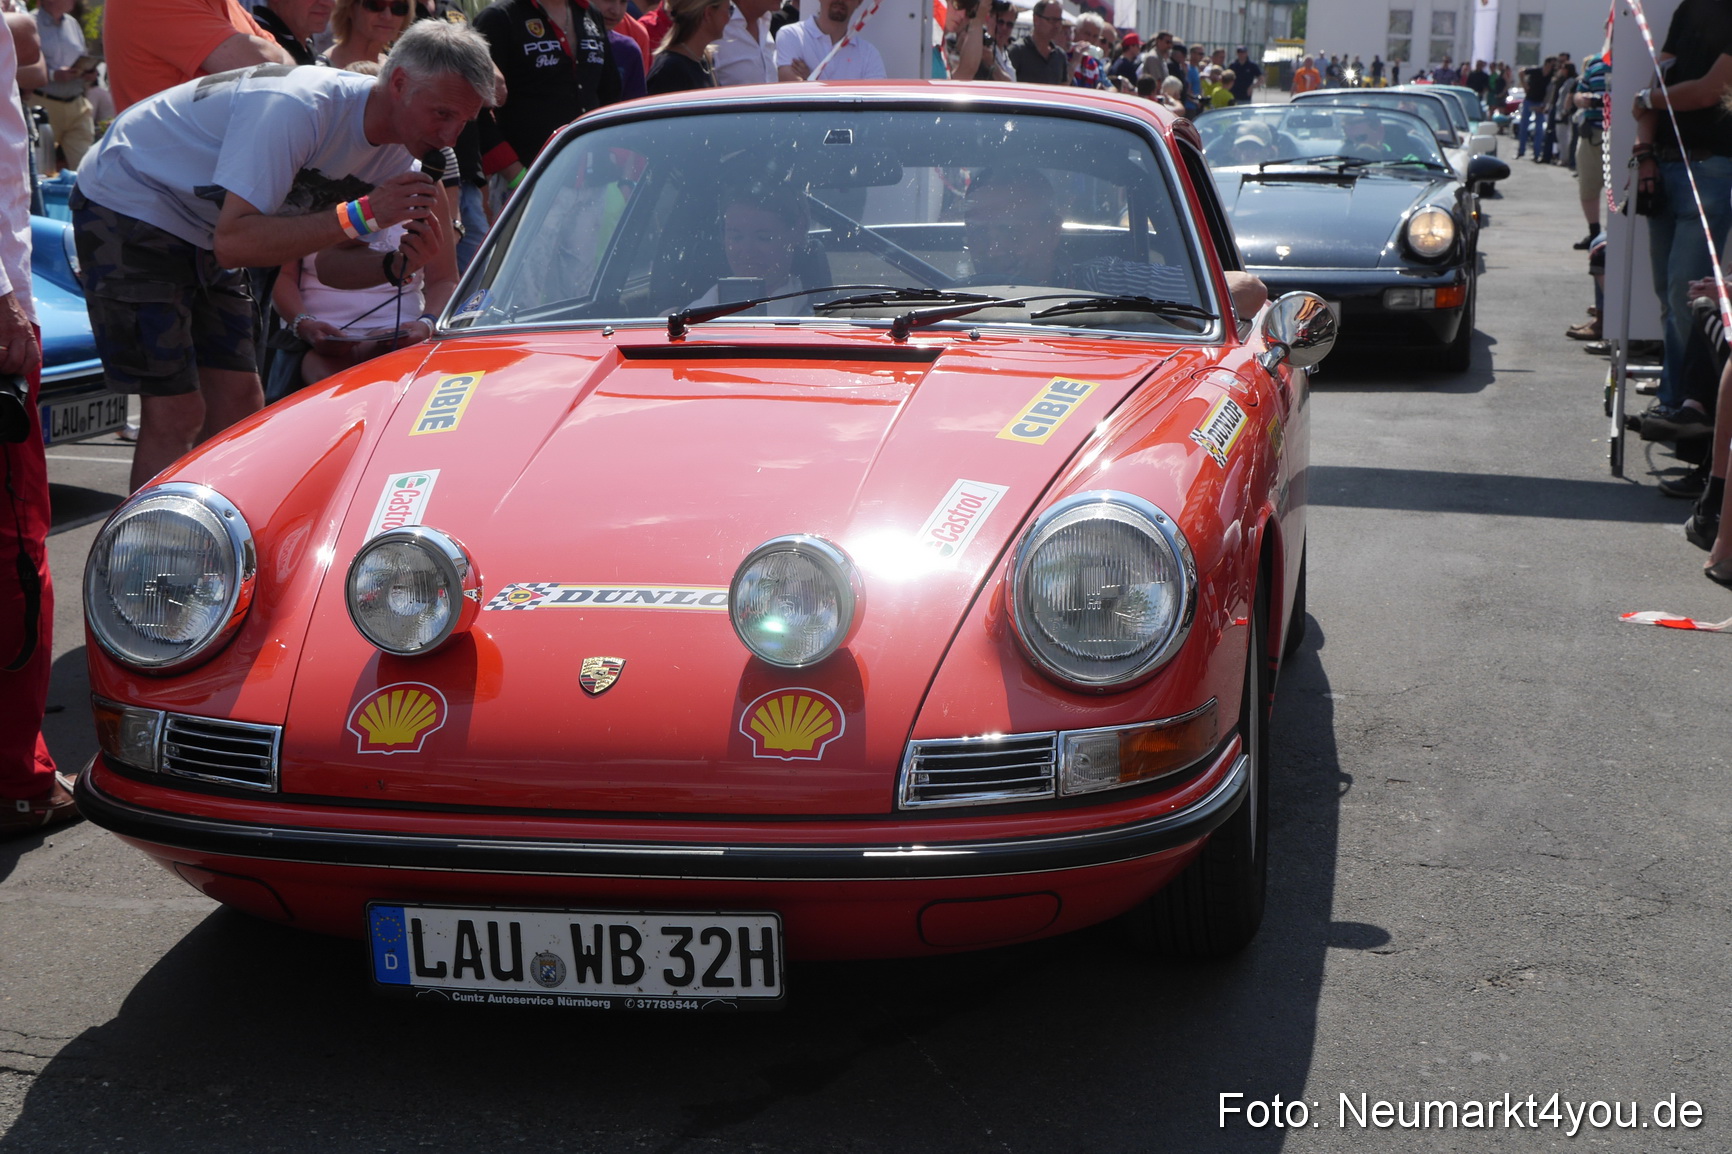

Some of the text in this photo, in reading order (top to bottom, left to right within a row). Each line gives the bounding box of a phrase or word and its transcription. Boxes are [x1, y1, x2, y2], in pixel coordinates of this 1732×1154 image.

[52, 405, 79, 437] LAU
[87, 400, 103, 430] FT
[1207, 399, 1242, 447] DUNLOP
[381, 489, 420, 531] Castro
[931, 492, 987, 543] Castrol
[550, 589, 729, 606] DUNLO
[384, 953, 399, 970] D
[411, 918, 523, 981] LAU
[570, 923, 645, 985] WB
[661, 926, 775, 987] 32H
[452, 992, 698, 1010] Cuntz Autoservice Nürnberg 37789544
